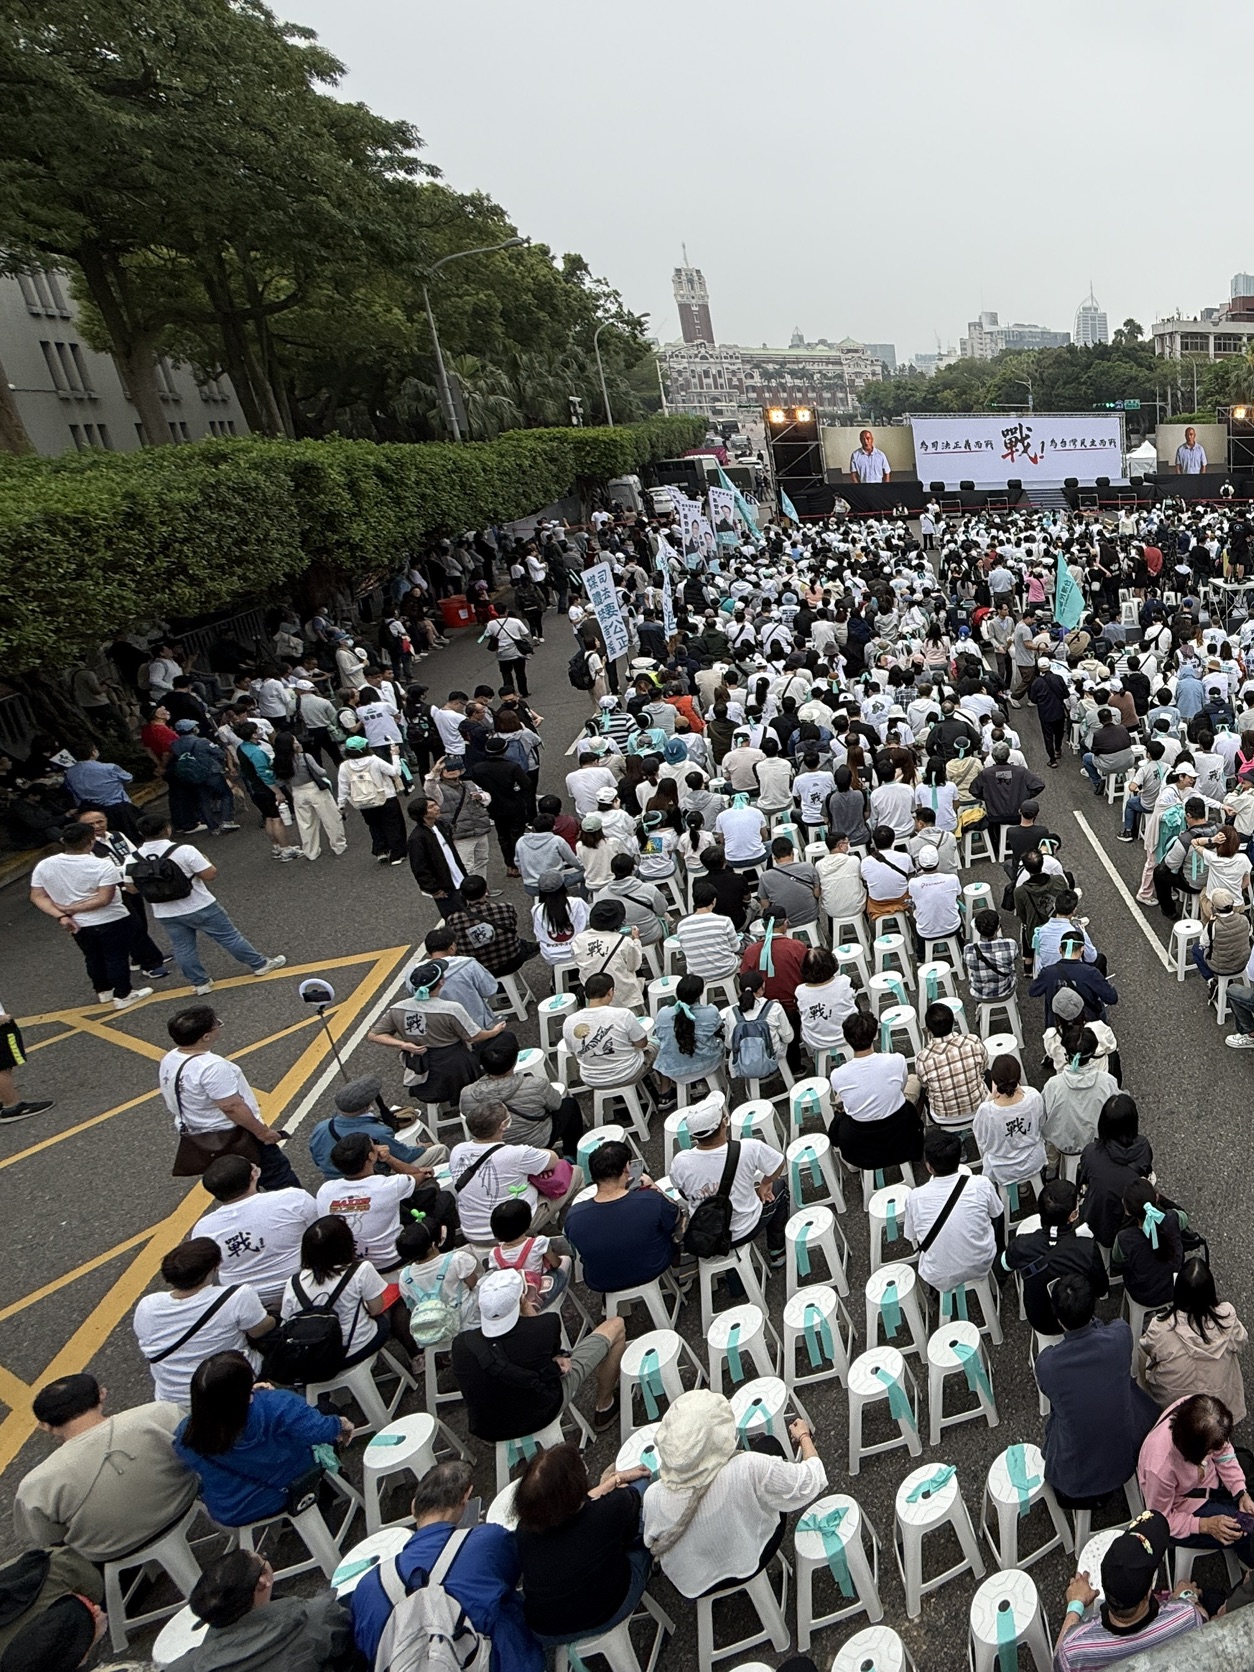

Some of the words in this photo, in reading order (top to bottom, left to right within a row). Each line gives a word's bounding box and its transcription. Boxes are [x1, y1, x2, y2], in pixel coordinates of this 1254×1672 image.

[920, 440, 994, 451] 為司法正義而戰
[1001, 422, 1045, 465] 戰!
[1050, 438, 1117, 448] 為台灣民主而戰
[586, 939, 610, 957] 戰!
[809, 1002, 832, 1021] 戰!
[1005, 1117, 1031, 1137] 戰!
[225, 1231, 265, 1257] 戰!
